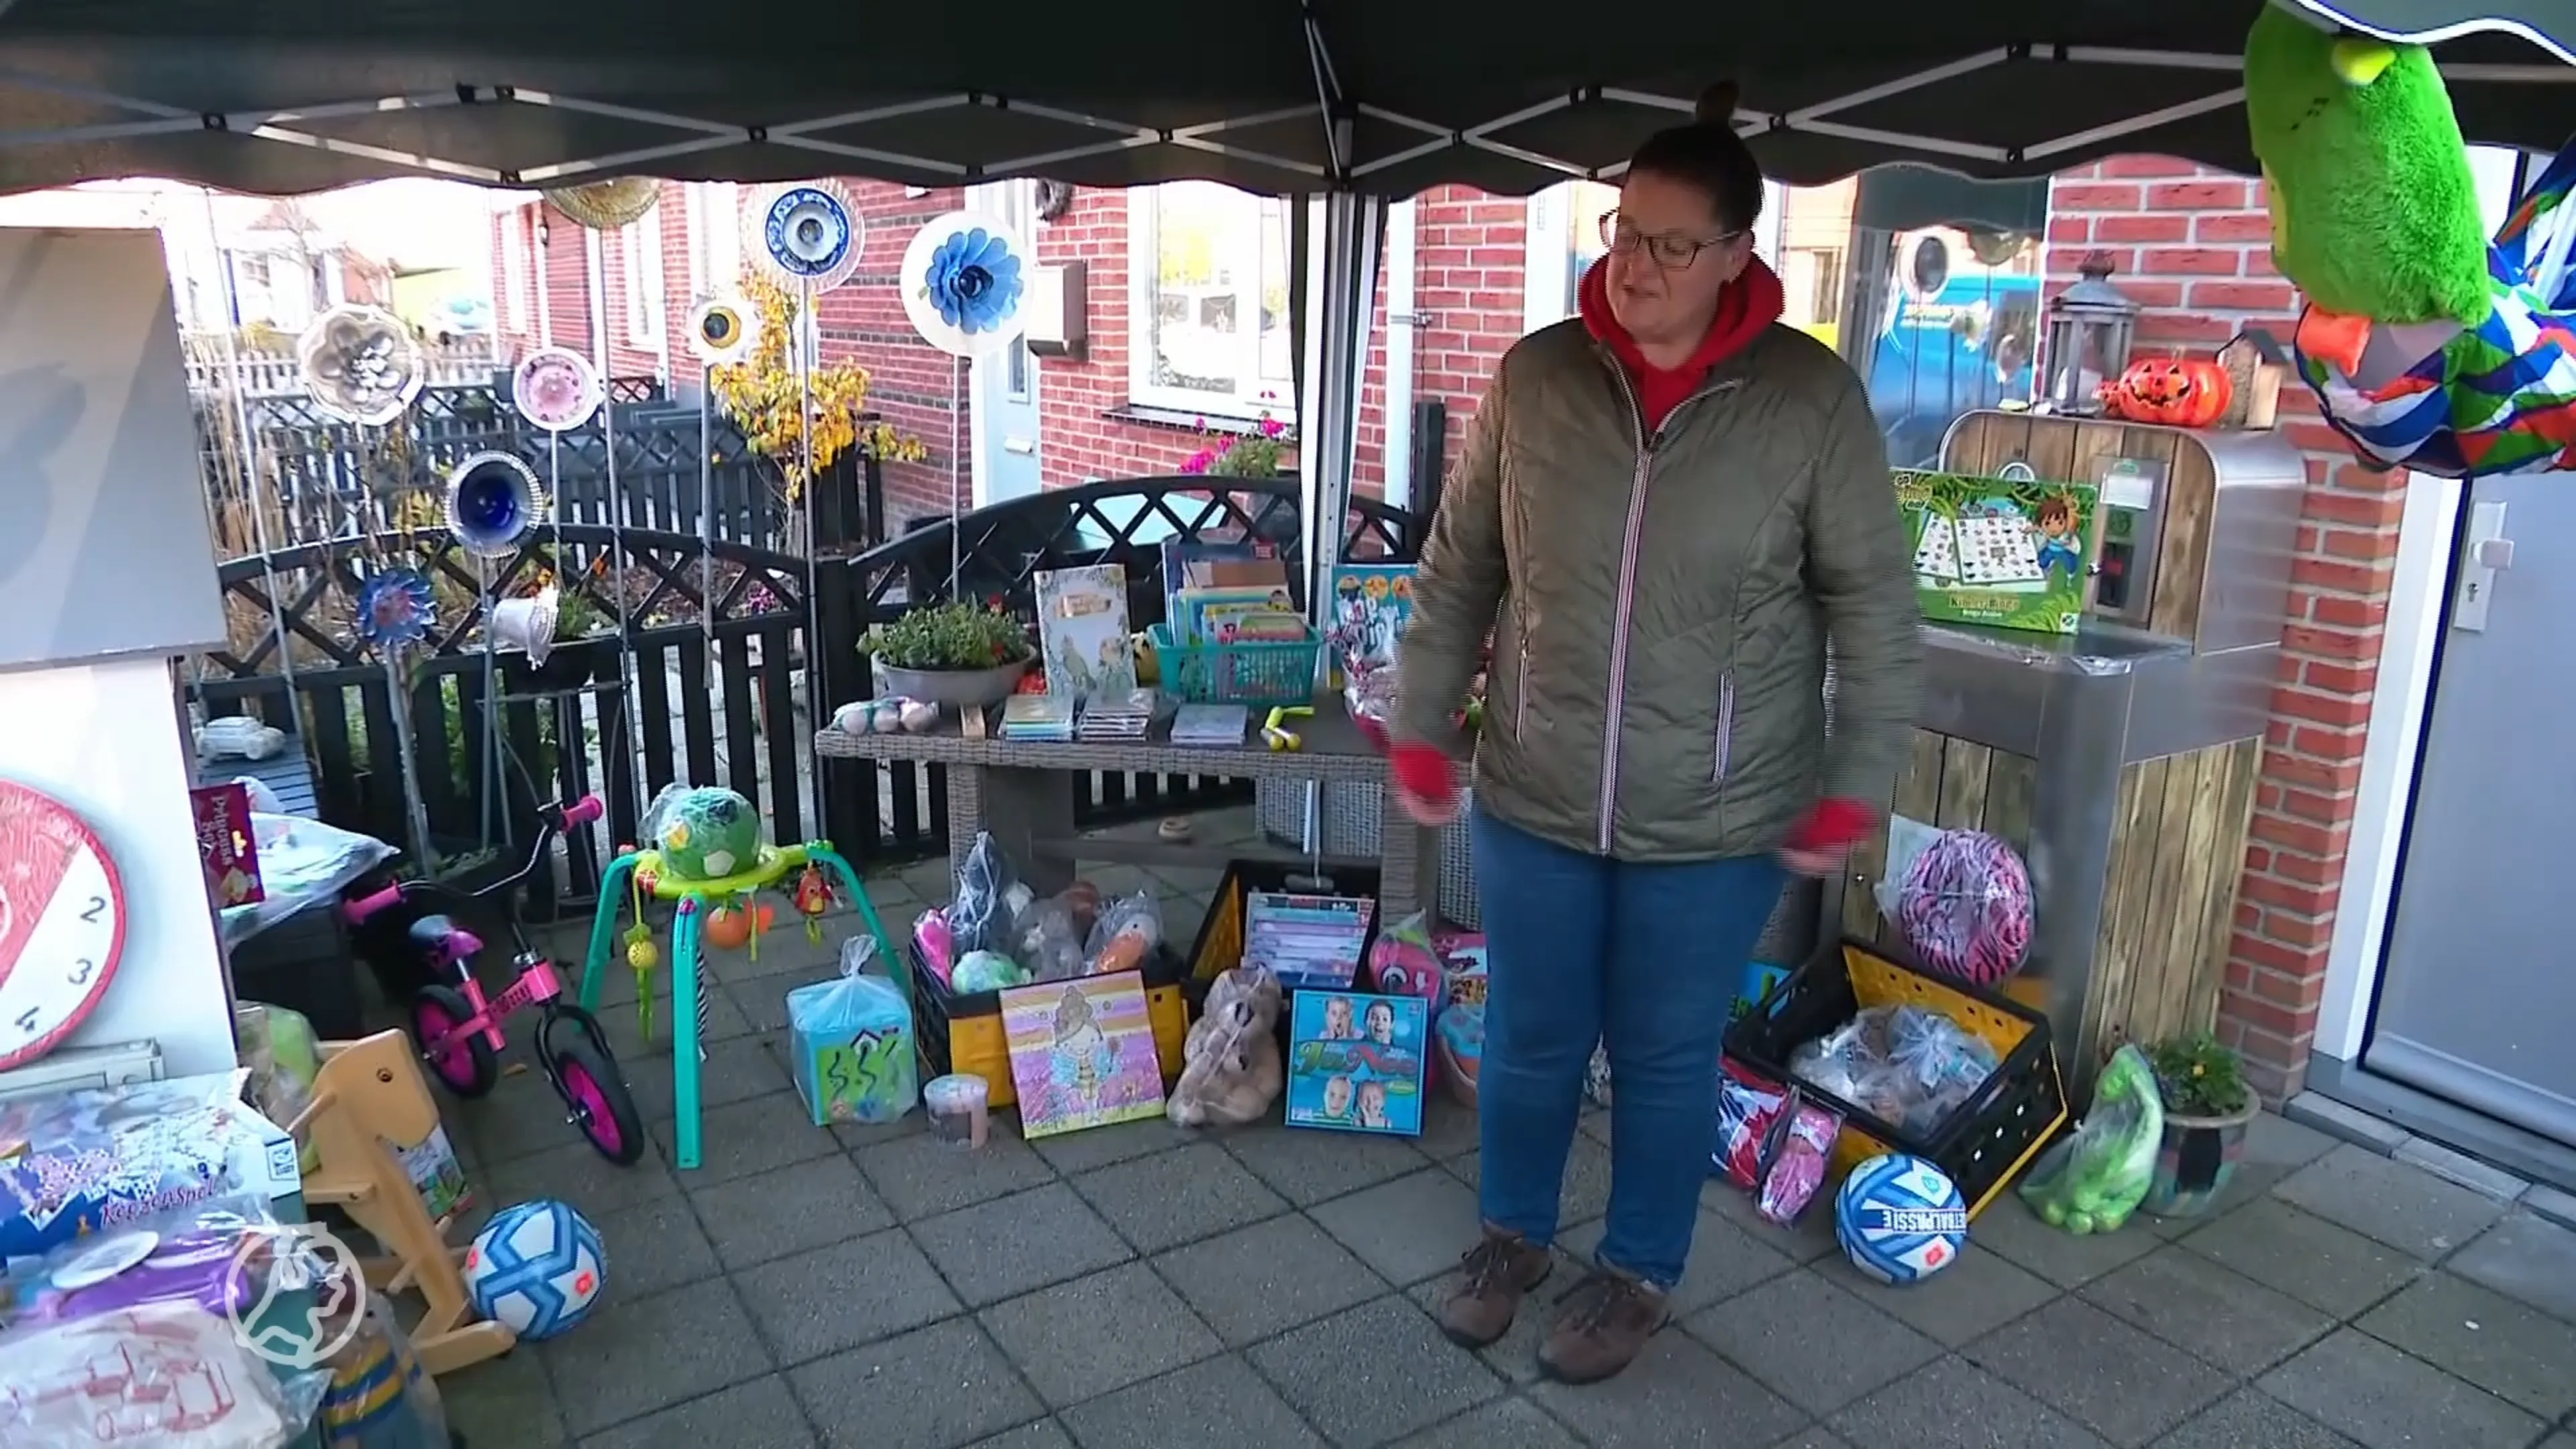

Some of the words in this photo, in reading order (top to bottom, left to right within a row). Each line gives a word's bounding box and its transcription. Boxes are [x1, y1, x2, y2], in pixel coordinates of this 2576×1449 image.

[79, 896, 107, 924] 2
[67, 957, 93, 985] 3
[14, 1006, 40, 1032] 4
